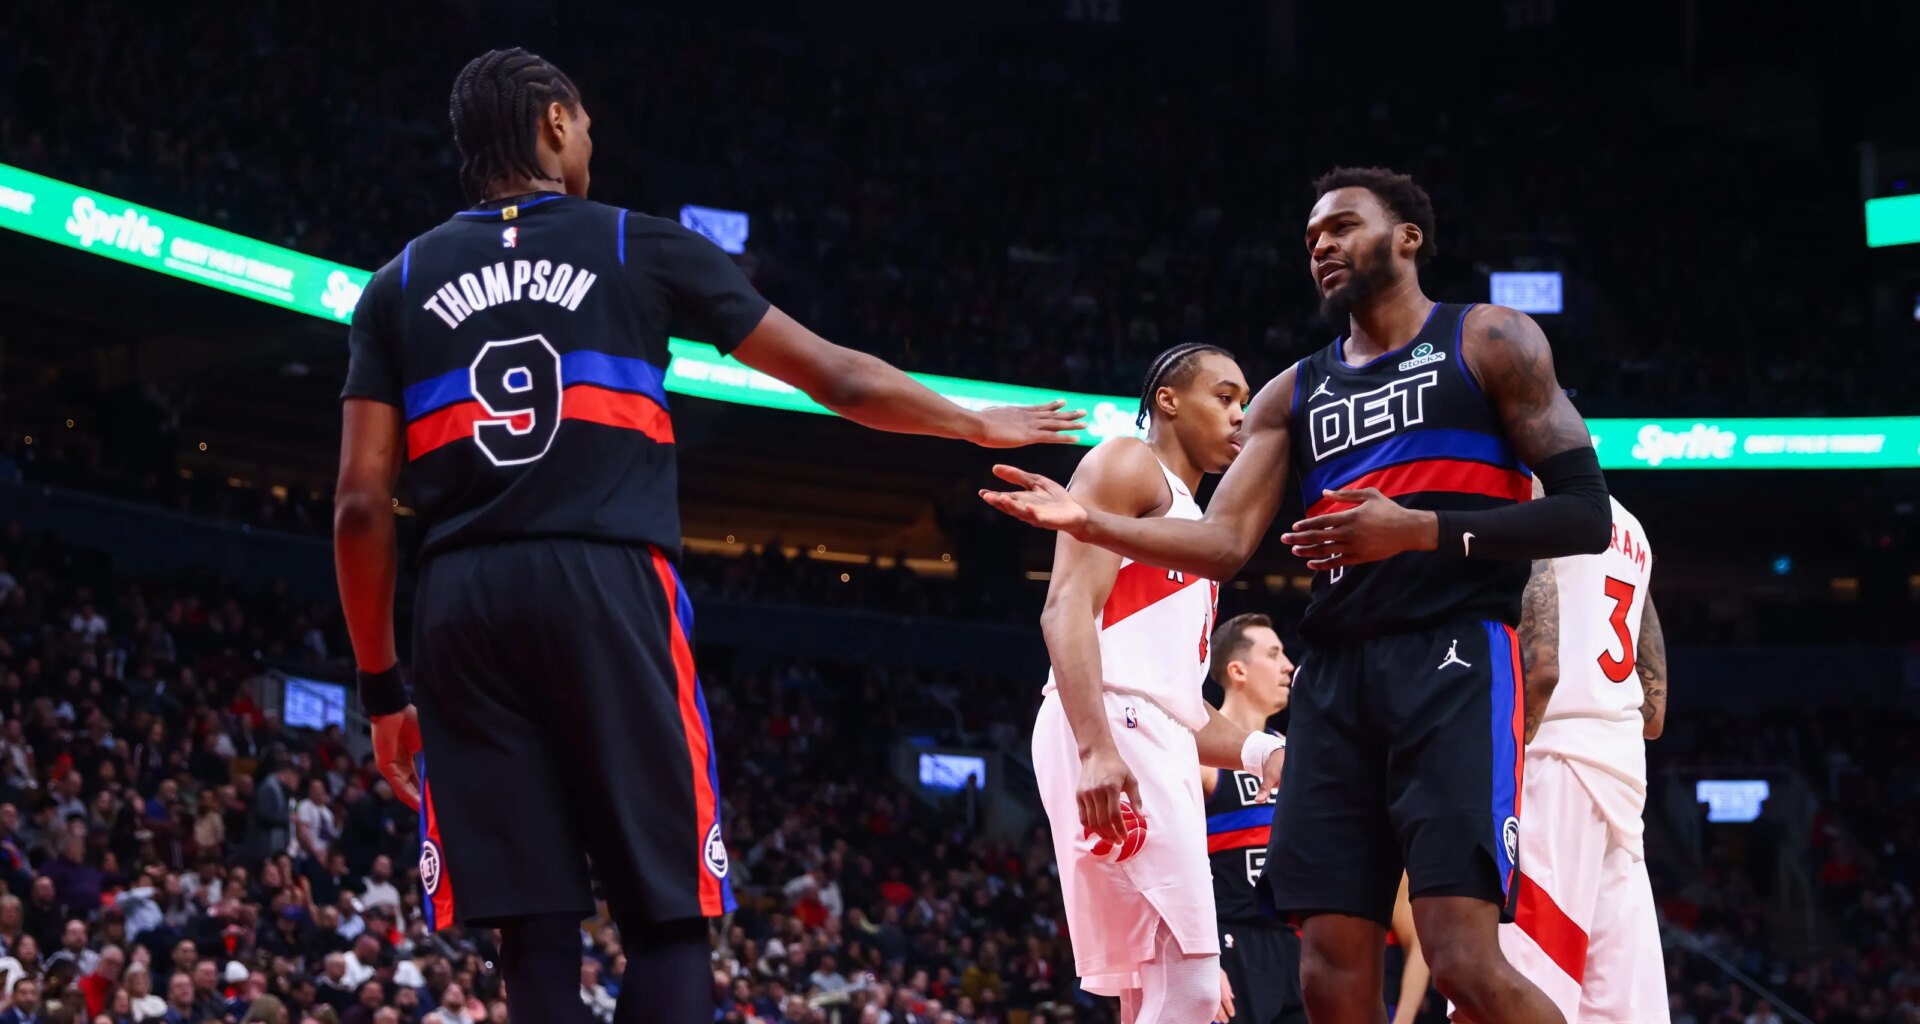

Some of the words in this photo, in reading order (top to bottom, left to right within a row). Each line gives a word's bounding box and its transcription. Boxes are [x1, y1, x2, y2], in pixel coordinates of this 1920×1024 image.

[66, 197, 164, 256] Sprite
[423, 260, 597, 329] THOMPSON
[469, 334, 563, 466] 9
[1309, 370, 1437, 462] DET
[1632, 424, 1736, 465] Sprite
[1597, 574, 1636, 684] 3
